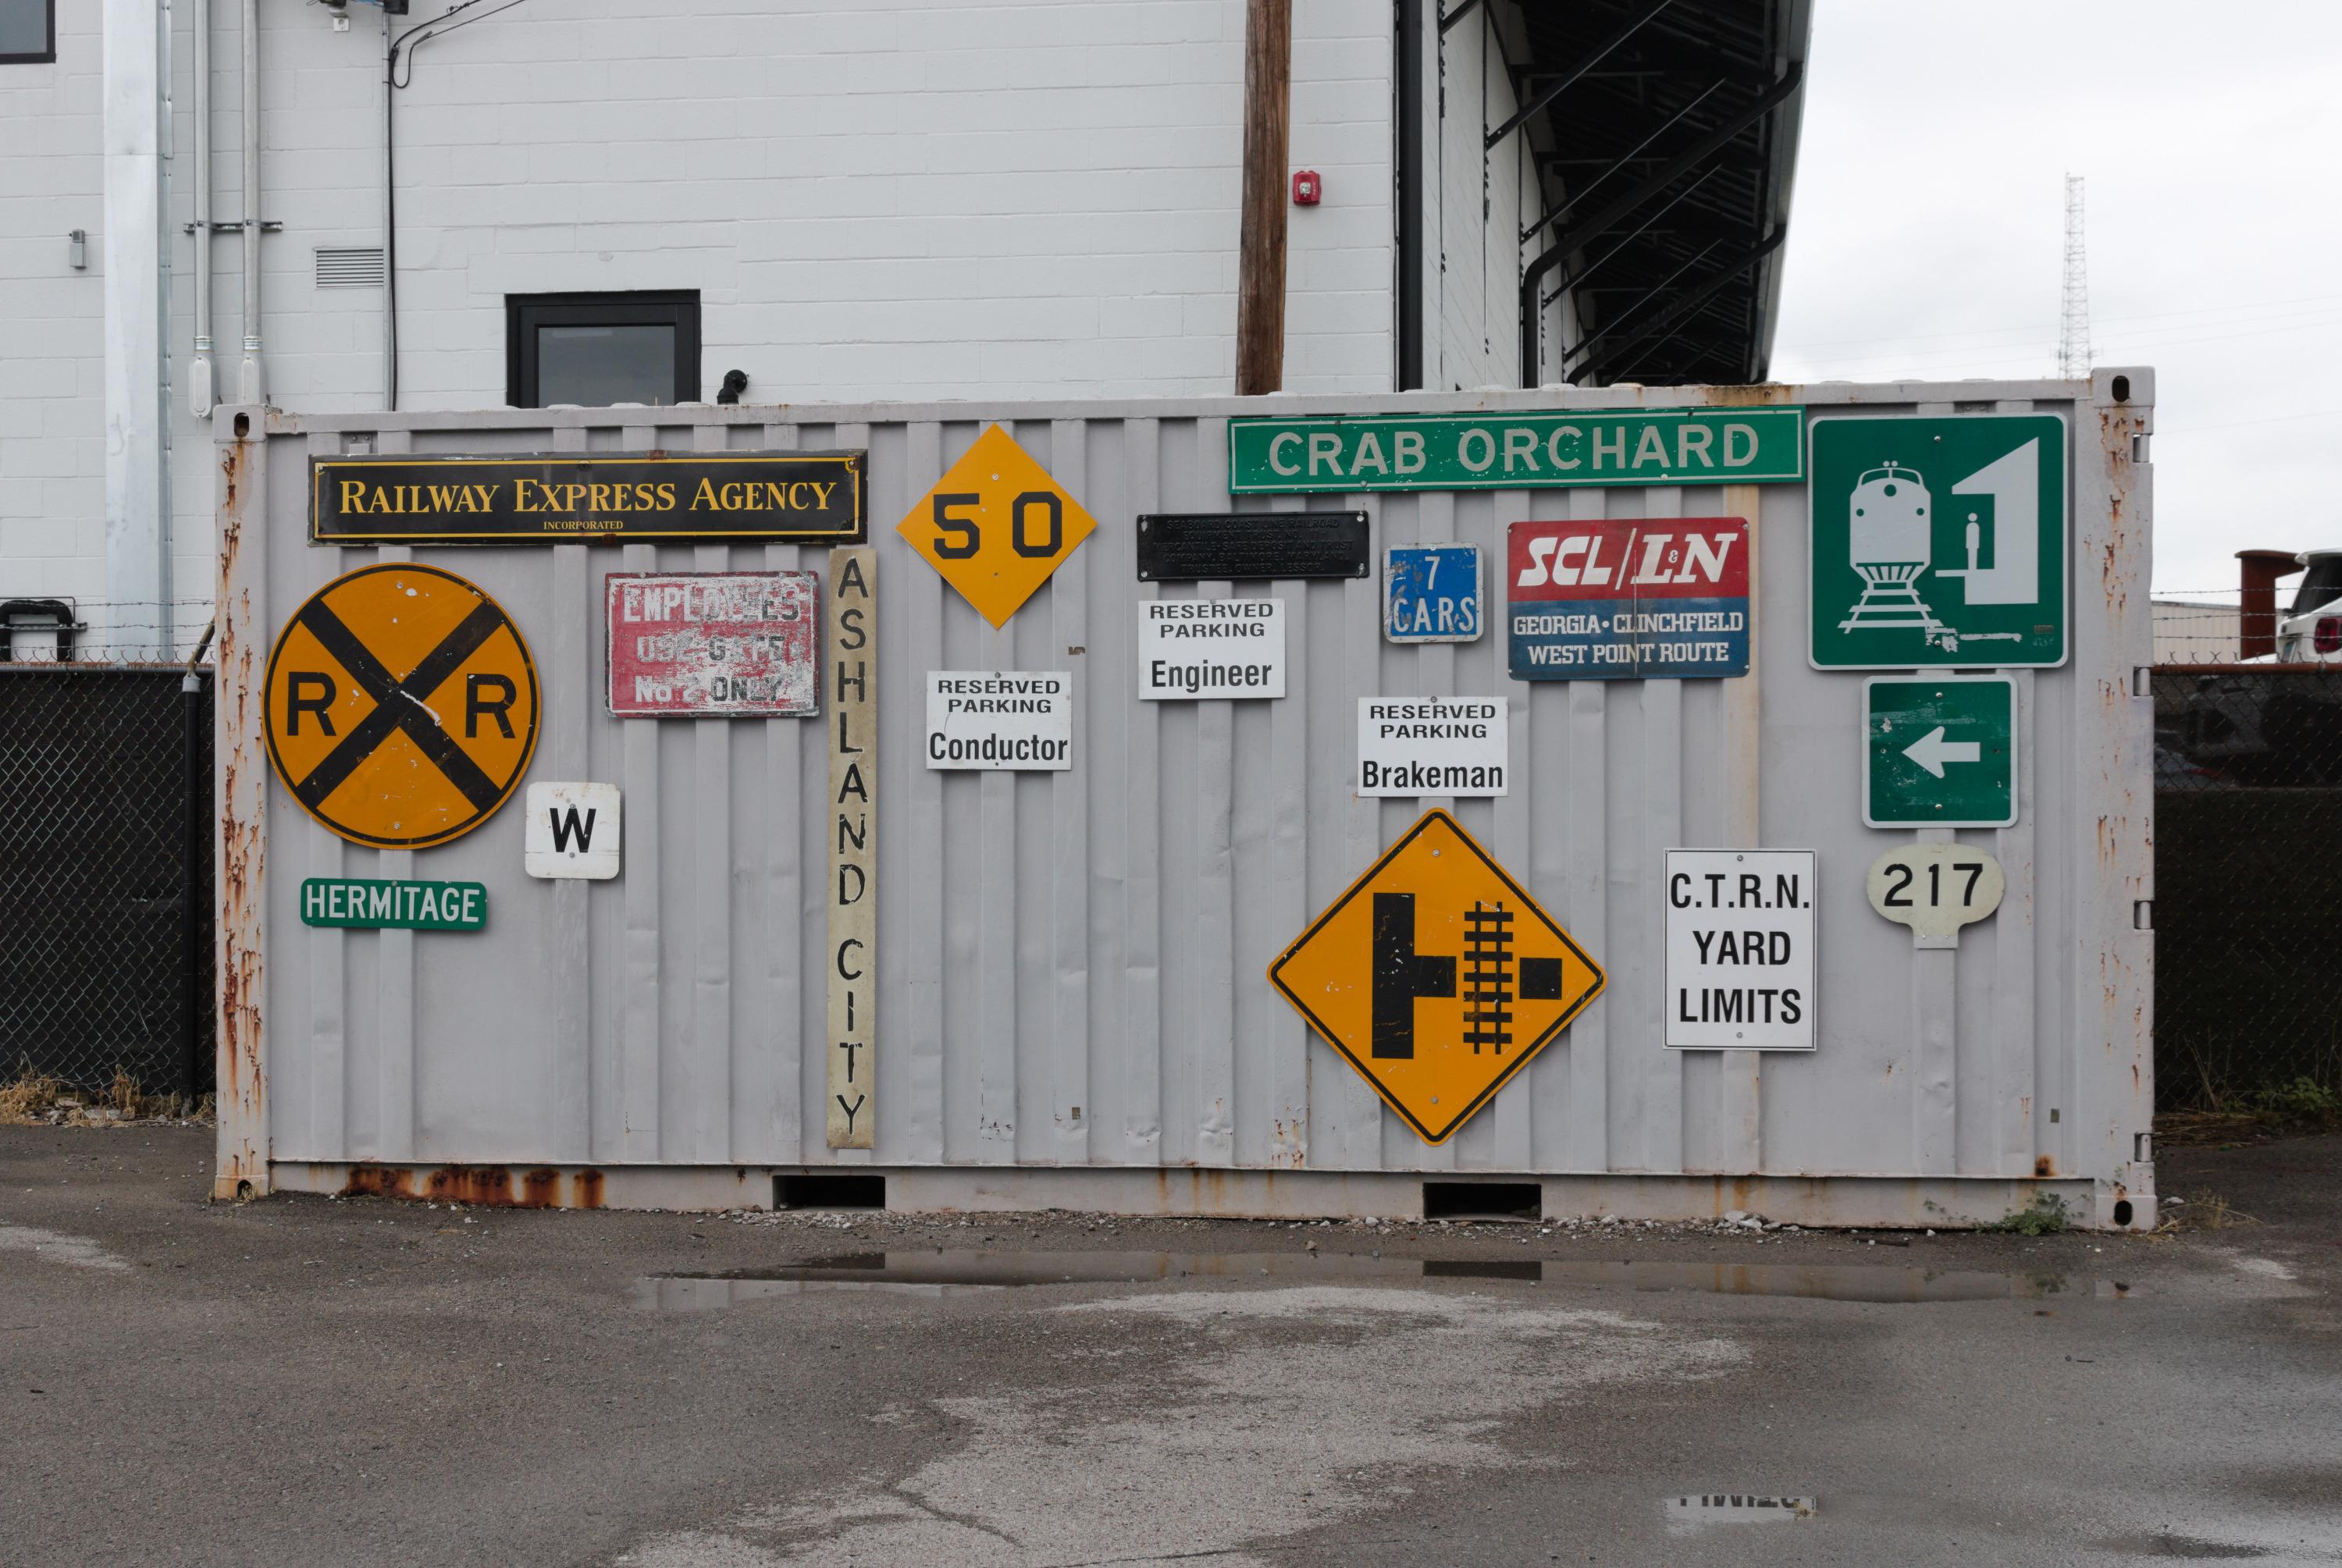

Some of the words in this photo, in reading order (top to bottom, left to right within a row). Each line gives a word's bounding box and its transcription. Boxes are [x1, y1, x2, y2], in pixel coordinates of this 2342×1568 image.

[1268, 431, 1426, 476] CRAB
[1458, 423, 1760, 472] ORCHARD
[339, 479, 500, 514] RAILWAY
[514, 478, 677, 513] EXPRESS
[689, 476, 838, 511] AGENCY
[542, 520, 625, 531] INCORPORATED
[1167, 519, 1221, 529] SEABOARD
[1225, 518, 1257, 528] COAST
[1287, 517, 1340, 528] RAILROAD
[1319, 540, 1353, 549] TRUST
[1424, 555, 1442, 591] 7
[623, 585, 801, 622] EMPLOYEES
[1149, 603, 1274, 619] RESERVED
[1393, 596, 1476, 632] CARS
[1159, 623, 1265, 638] PARKING
[636, 636, 694, 663] USE
[708, 635, 785, 662] GATE
[1527, 645, 1588, 665] WEST
[1593, 643, 1654, 663] POINT
[1659, 642, 1729, 663] ROUTE
[710, 676, 783, 702] ONLY
[938, 680, 1060, 695] RESERVED
[1151, 660, 1272, 693] Engineer
[287, 671, 337, 737] R
[464, 674, 517, 739] R
[948, 699, 1052, 714] PARKING
[1369, 704, 1497, 720] RESERVED
[838, 557, 869, 905] ASHLAND
[929, 733, 1069, 762] Conductor
[1380, 724, 1488, 740] PARKING
[1362, 760, 1504, 788] Brakeman
[550, 807, 596, 854] W
[1671, 872, 1810, 908] C.T.R.N.
[1883, 862, 1984, 907] 217
[305, 884, 481, 923] HERMITAGE
[1692, 930, 1792, 966] YARD
[1679, 987, 1802, 1025] LIMITS
[836, 938, 866, 1135] CITY
